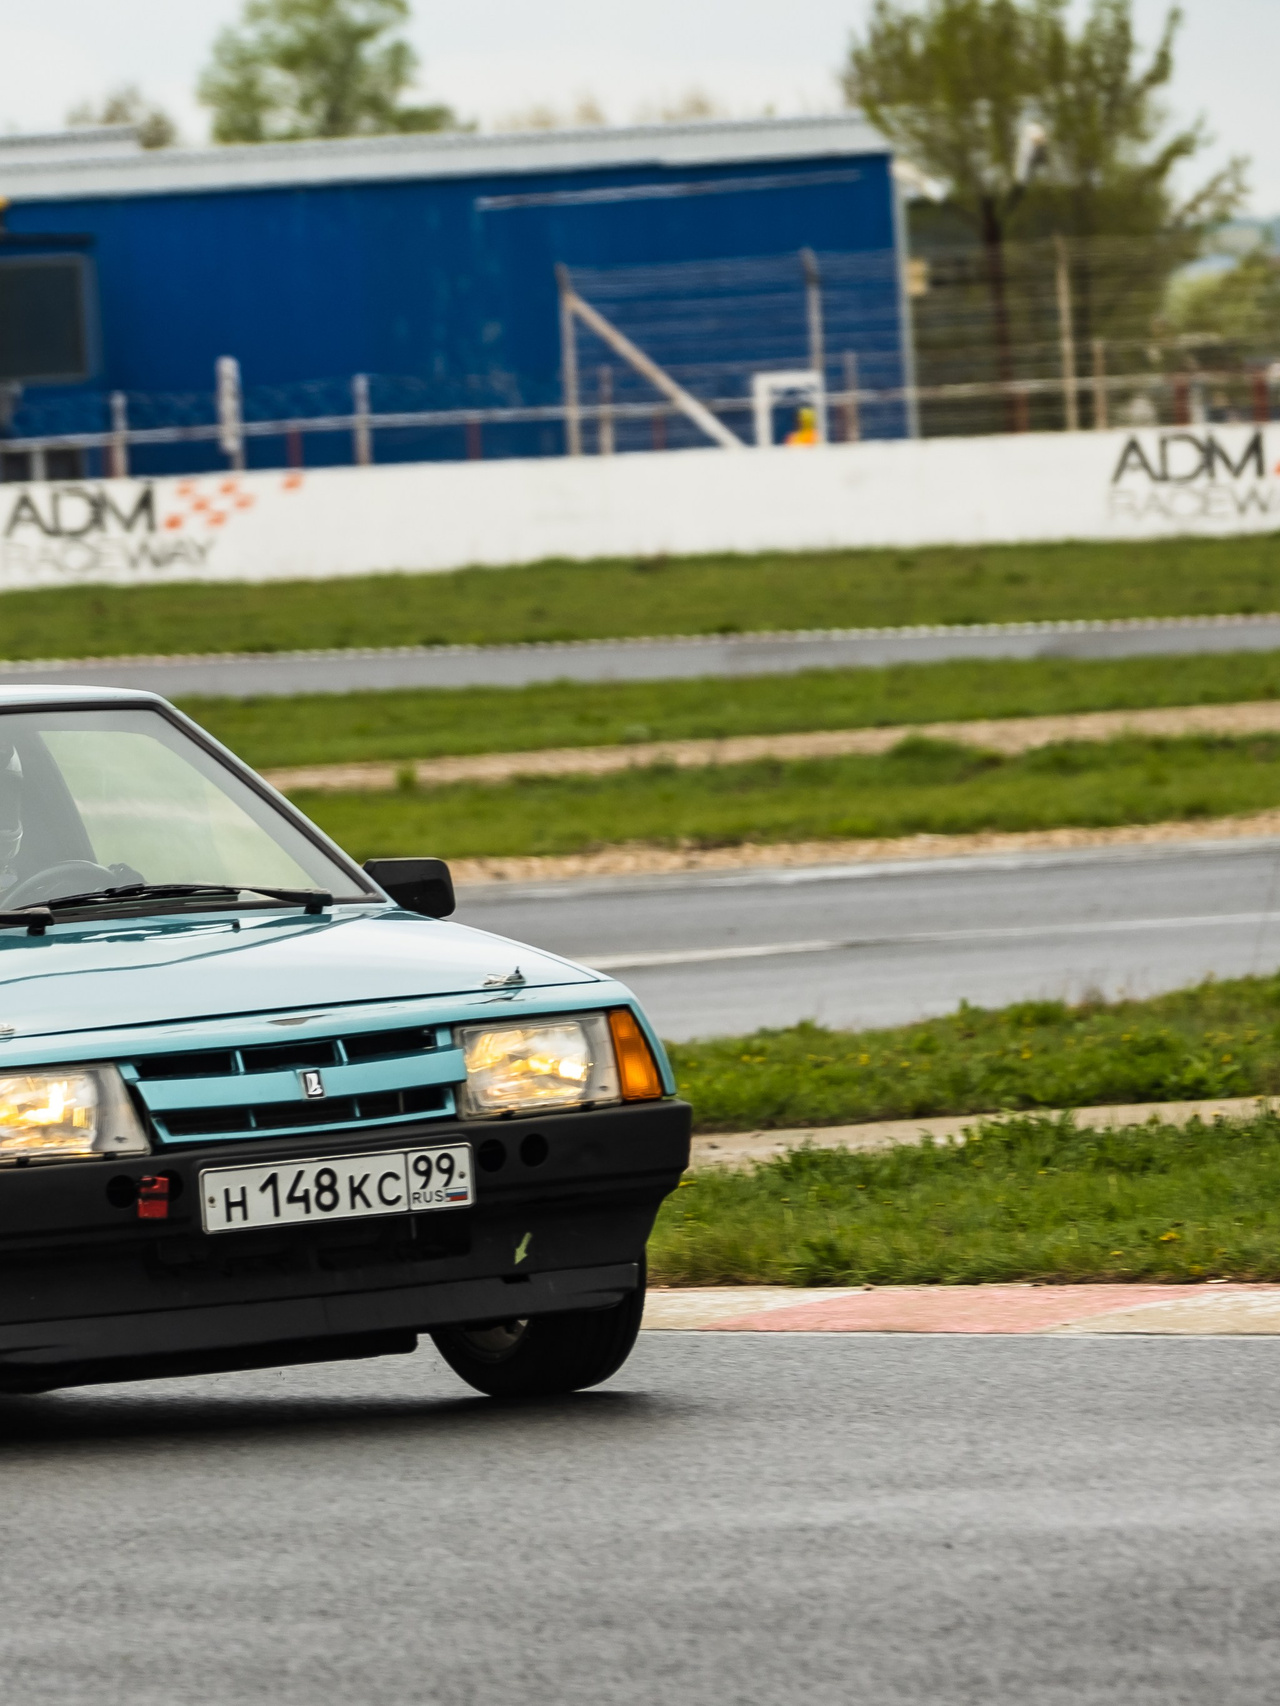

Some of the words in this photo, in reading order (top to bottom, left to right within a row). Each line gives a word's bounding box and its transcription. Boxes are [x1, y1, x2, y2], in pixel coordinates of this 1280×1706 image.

[1111, 429, 1267, 485] ADM
[4, 482, 157, 538] ADM
[1107, 485, 1279, 521] RACEW
[412, 1152, 456, 1190] 99
[412, 1189, 444, 1204] RUS
